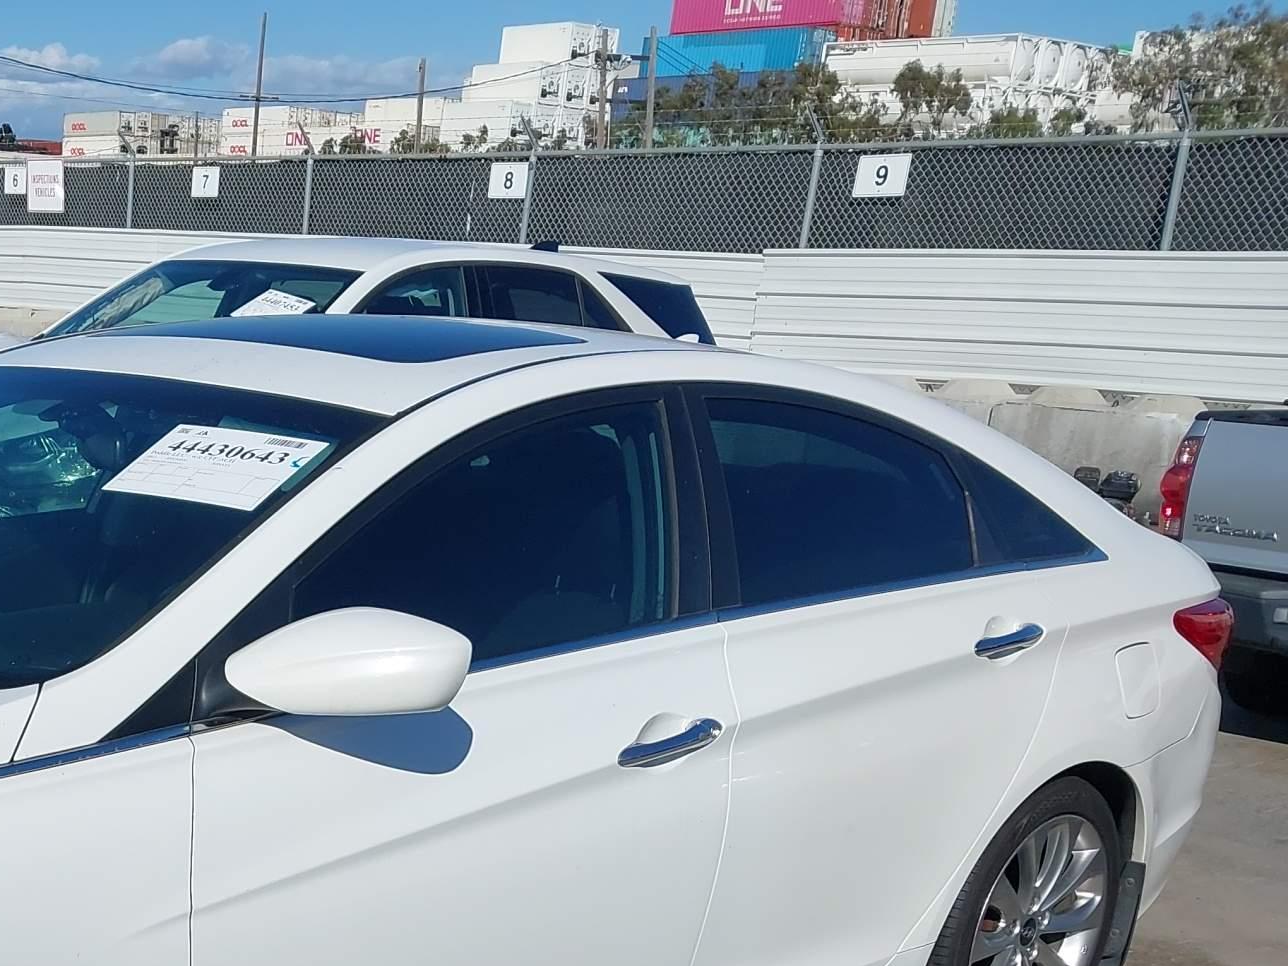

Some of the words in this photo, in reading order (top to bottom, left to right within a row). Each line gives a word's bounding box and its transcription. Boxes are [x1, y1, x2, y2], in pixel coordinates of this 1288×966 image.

[12, 174, 19, 188] 6
[202, 174, 210, 189] 7
[503, 171, 514, 190] 8
[875, 165, 889, 186] 9
[168, 439, 290, 465] 44430643
[1193, 513, 1231, 525] TOYOTA
